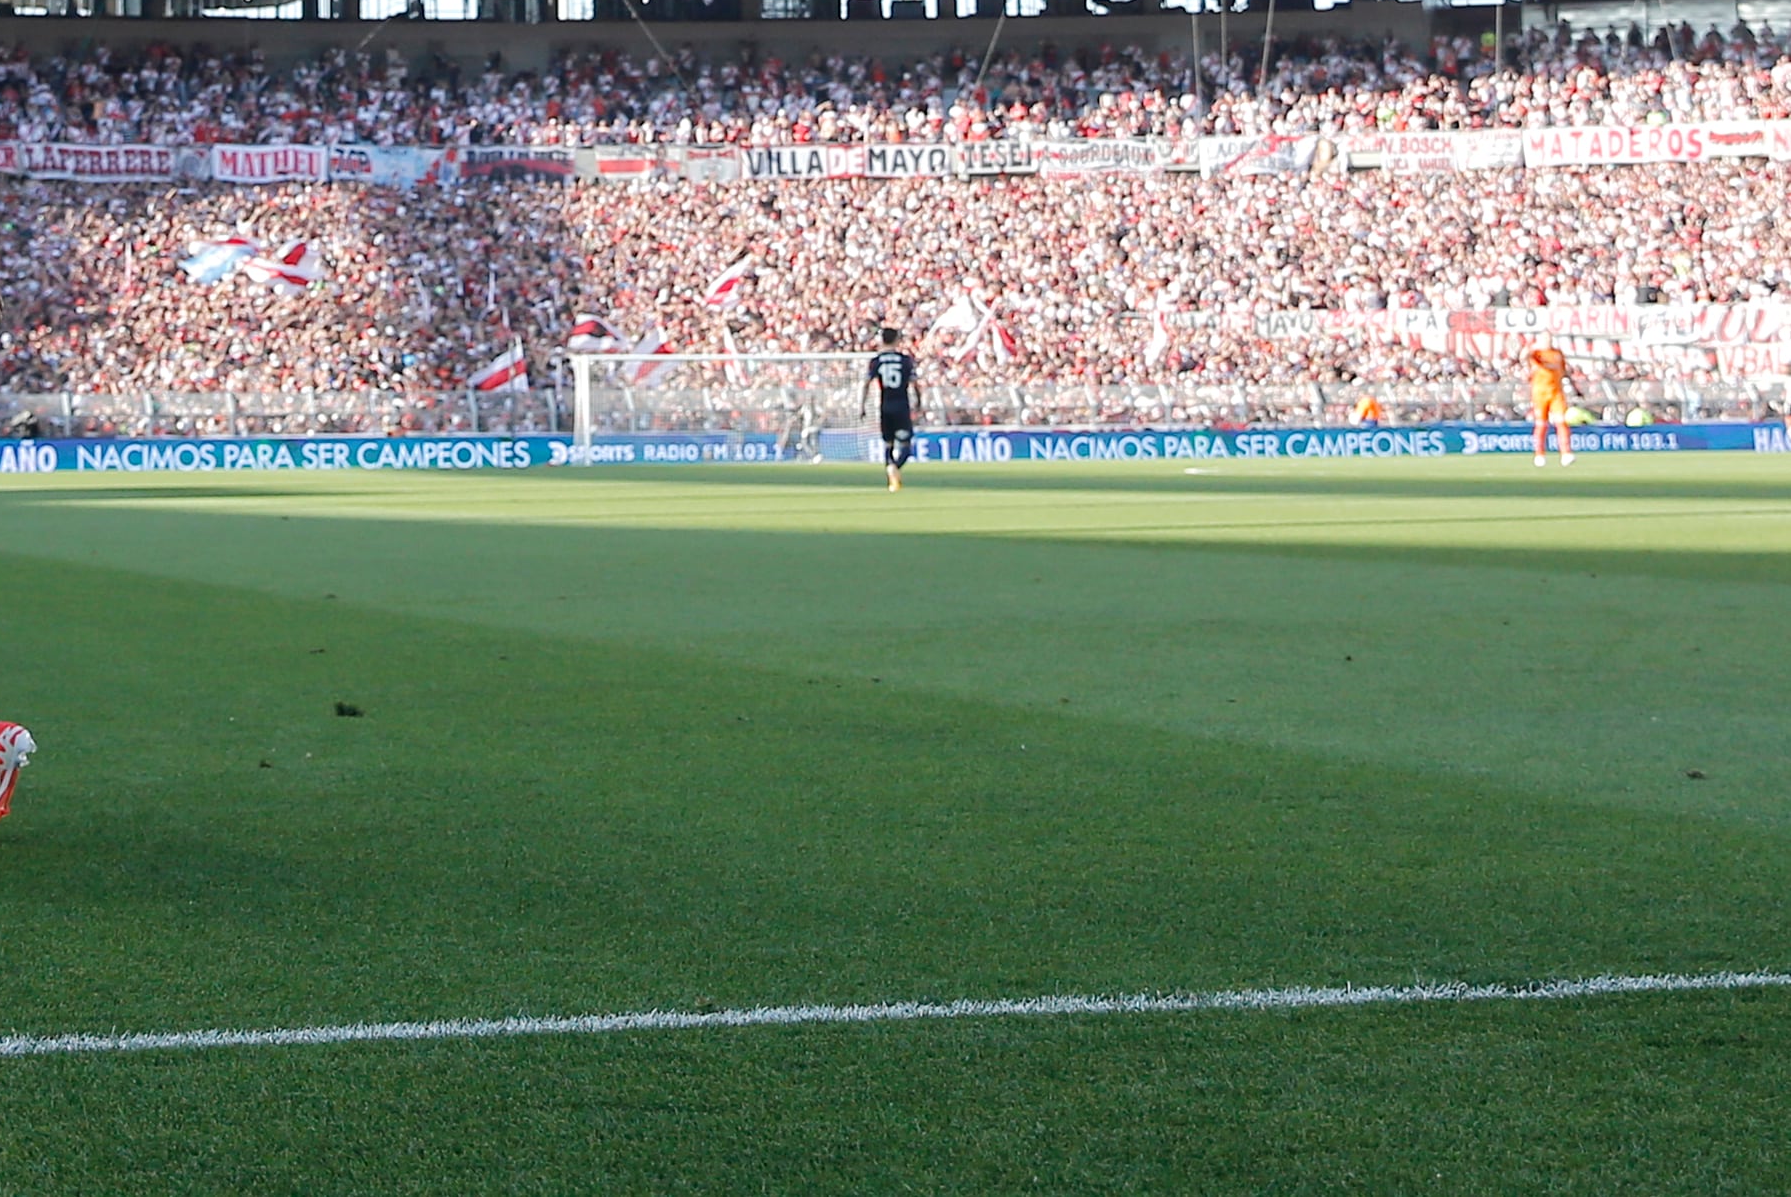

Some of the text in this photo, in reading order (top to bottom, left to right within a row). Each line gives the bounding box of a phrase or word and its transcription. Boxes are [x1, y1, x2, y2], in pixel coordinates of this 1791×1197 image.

[1530, 129, 1703, 160] MATADEROS
[746, 149, 824, 175] VILLA
[868, 148, 947, 175] MAYO
[878, 363, 902, 389] 15
[0, 439, 58, 473] AÑO
[77, 441, 532, 471] NACIMOS PARA SER CAMPEONES
[643, 443, 699, 461] RADIO
[868, 431, 1012, 463] HE 1 AÑO
[1028, 430, 1446, 461] NACIMOS PARA SER CAMPEONES
[1548, 432, 1600, 451] RDIO
[1602, 432, 1628, 451] FM
[1630, 432, 1678, 451] 103.1
